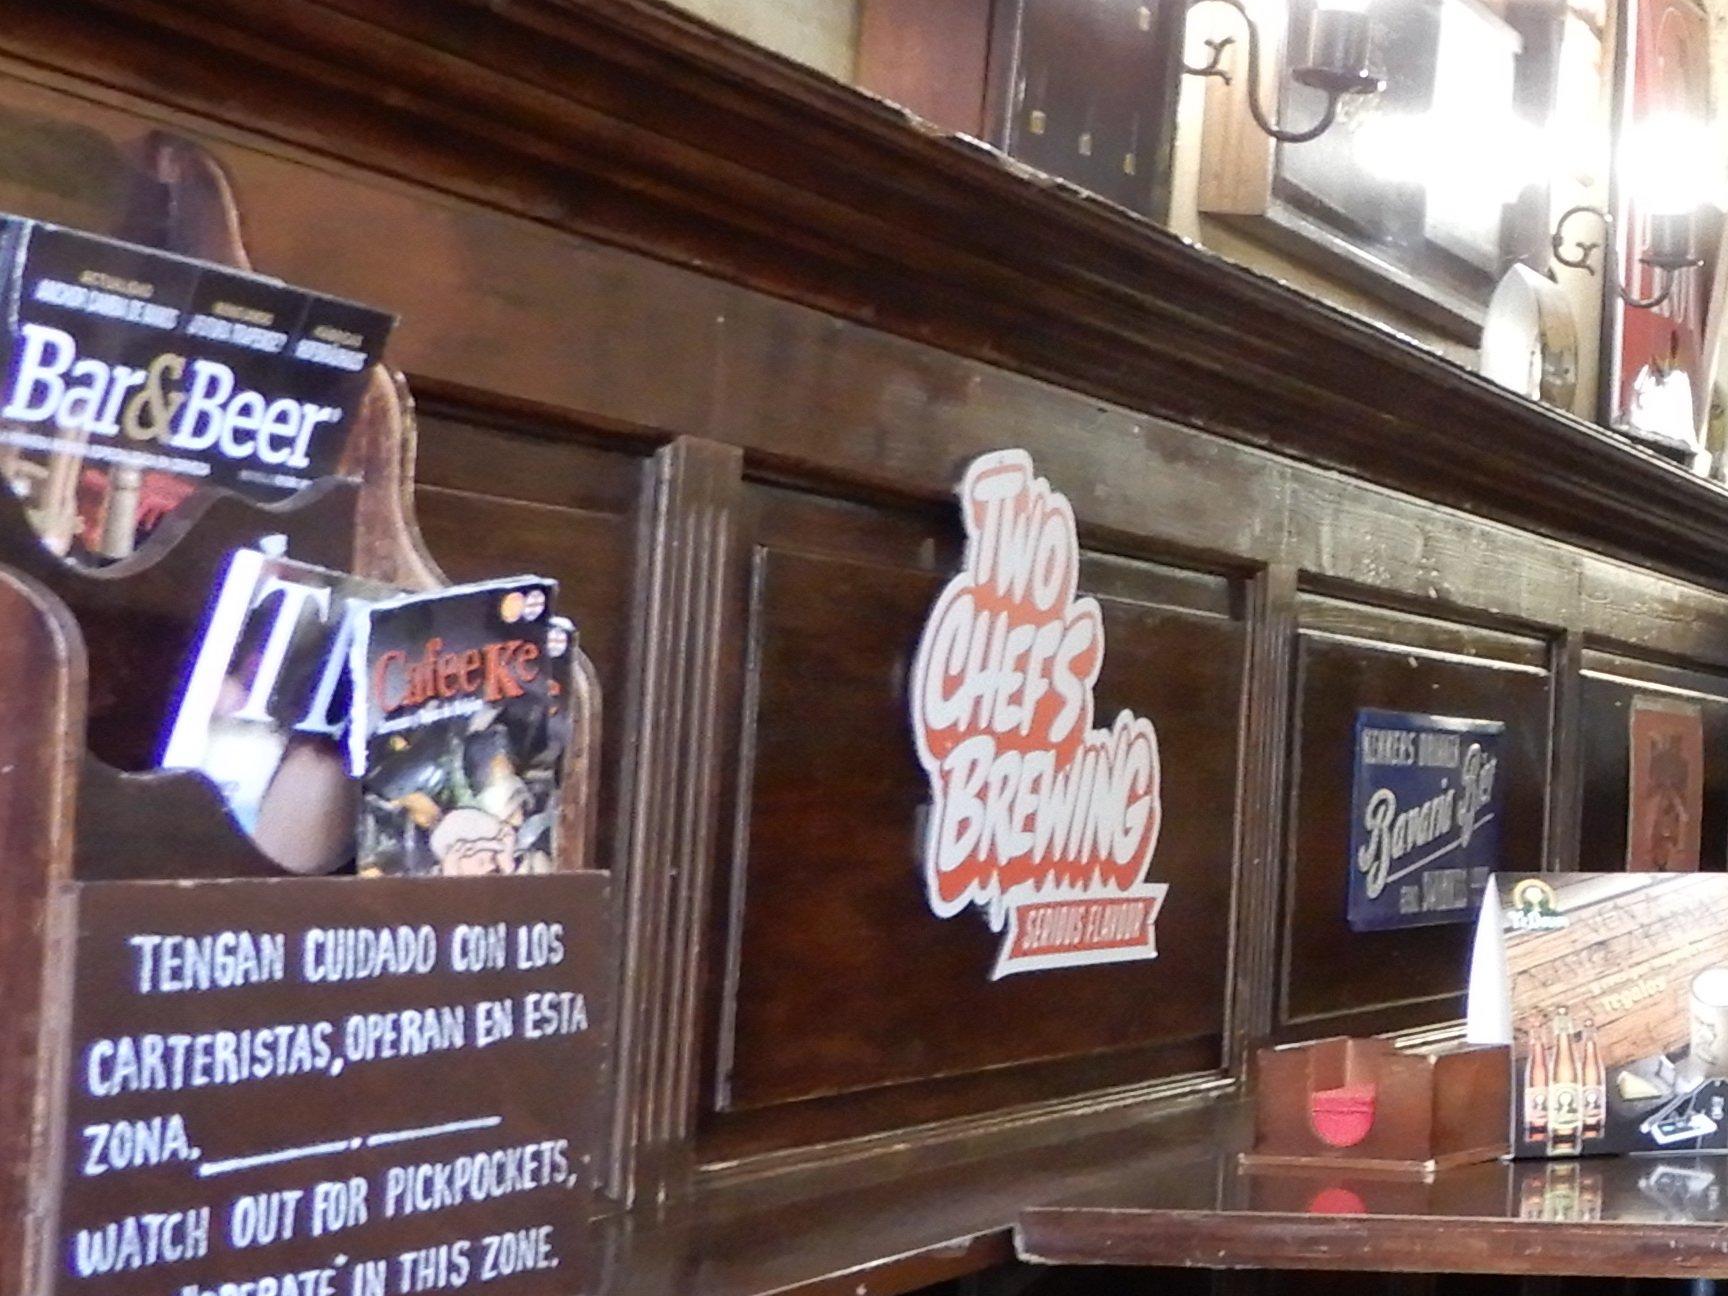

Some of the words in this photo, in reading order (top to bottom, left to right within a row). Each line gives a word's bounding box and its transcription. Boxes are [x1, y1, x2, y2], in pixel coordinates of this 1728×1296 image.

[971, 470, 1066, 612] TWO
[926, 594, 1097, 743] CHEFS
[936, 734, 1153, 874] BREWING
[128, 930, 286, 994] TENGAN
[303, 924, 438, 983] CUIDADO
[451, 923, 507, 973] CON
[517, 921, 564, 969] LOS
[345, 1003, 466, 1062] OPERAN
[473, 998, 514, 1048] EN
[523, 991, 589, 1037] ESTA
[82, 1113, 202, 1177] ZONA.
[74, 1205, 211, 1279] WATCH
[230, 1189, 303, 1249] OUT
[312, 1176, 368, 1237] FOR
[384, 1138, 578, 1220] PICKPOCKETS,
[398, 1237, 470, 1291] THIS
[480, 1225, 560, 1281] ZONE.
